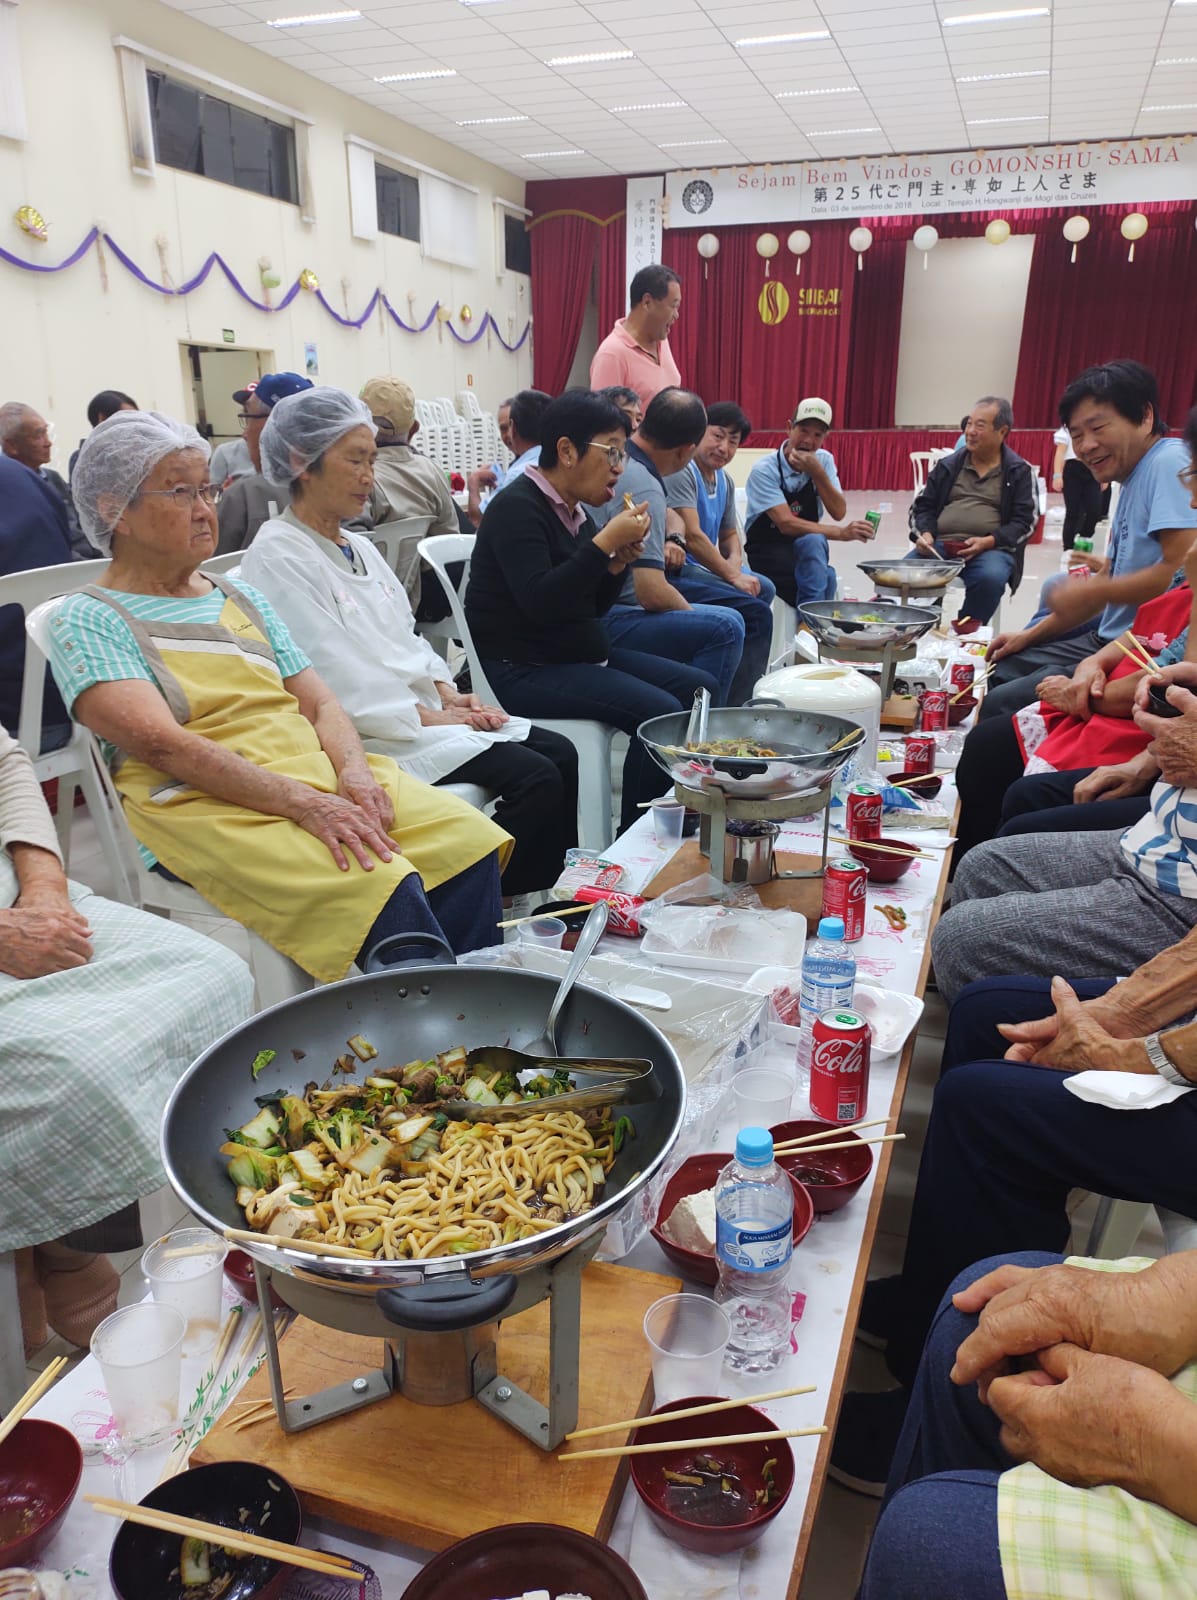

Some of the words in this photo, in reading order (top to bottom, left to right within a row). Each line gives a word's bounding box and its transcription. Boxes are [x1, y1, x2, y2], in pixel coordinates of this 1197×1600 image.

[737, 172, 796, 191] Sejam
[807, 169, 848, 185] Bem
[862, 163, 932, 181] Vindos
[851, 203, 884, 211] setembro
[947, 199, 973, 208] Templo
[1035, 194, 1053, 203] Mogi
[1055, 193, 1069, 201] das
[1070, 192, 1097, 200] Cruzes
[853, 801, 881, 818] Coca
[814, 1038, 863, 1073] Cola
